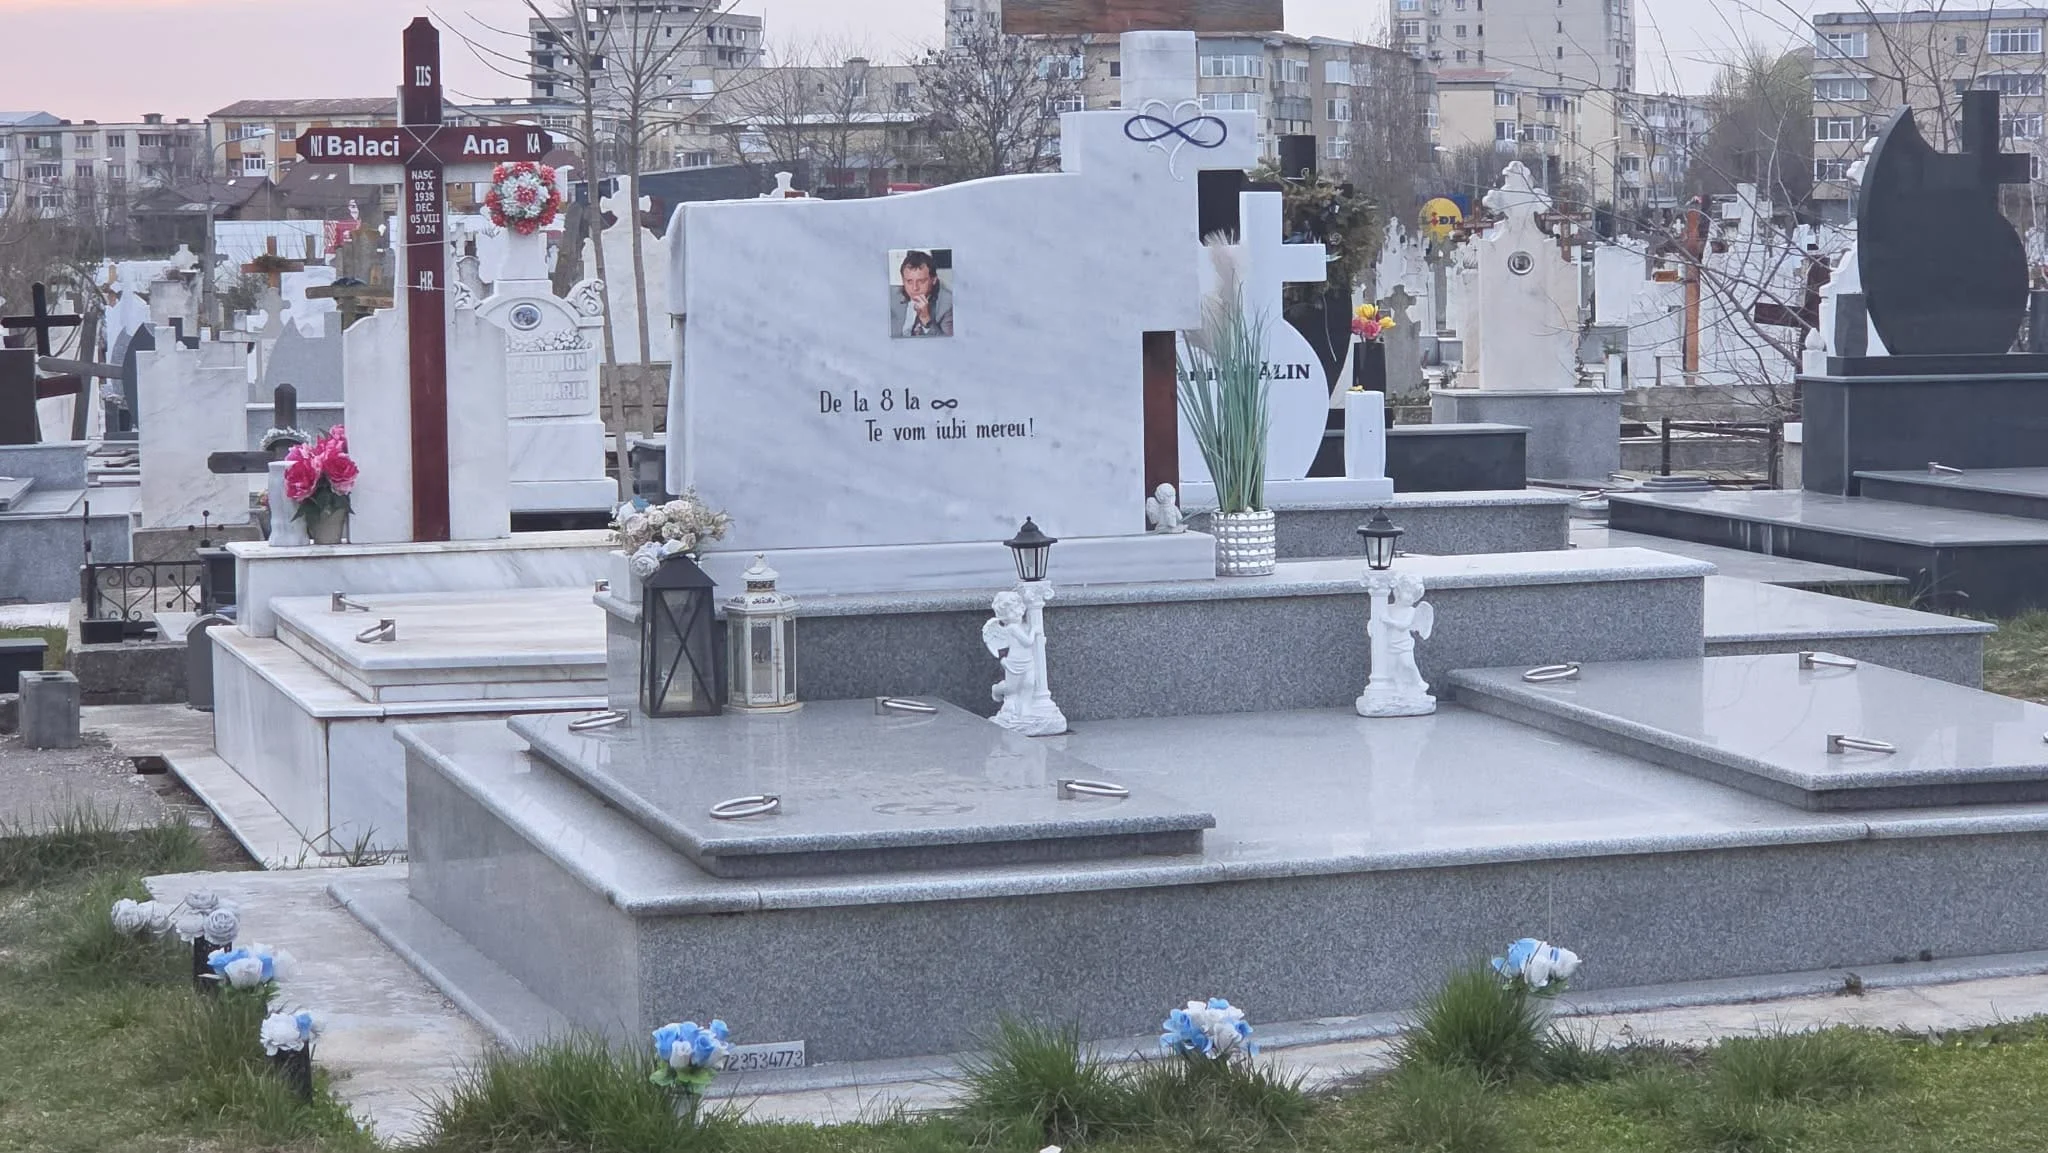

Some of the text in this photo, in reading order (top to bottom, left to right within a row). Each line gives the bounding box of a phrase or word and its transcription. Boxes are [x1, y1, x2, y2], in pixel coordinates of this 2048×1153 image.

[416, 66, 431, 86] IIS
[310, 133, 541, 157] NI Balaci Ana KA
[412, 170, 436, 180] NASC.
[415, 181, 433, 191] 02 X
[415, 192, 435, 202] 1938
[416, 203, 434, 213] DEC.
[410, 213, 440, 224] 05 VIII
[415, 225, 436, 235] 2024
[419, 270, 434, 291] HR
[1249, 360, 1310, 380] ĂLIN
[820, 390, 842, 413] De
[854, 390, 869, 412] la
[880, 388, 893, 411] 8
[905, 388, 920, 410] la
[865, 419, 883, 442] Te
[893, 425, 926, 441] vom
[936, 417, 967, 440] iubi
[718, 1050, 803, 1071] 723534773
